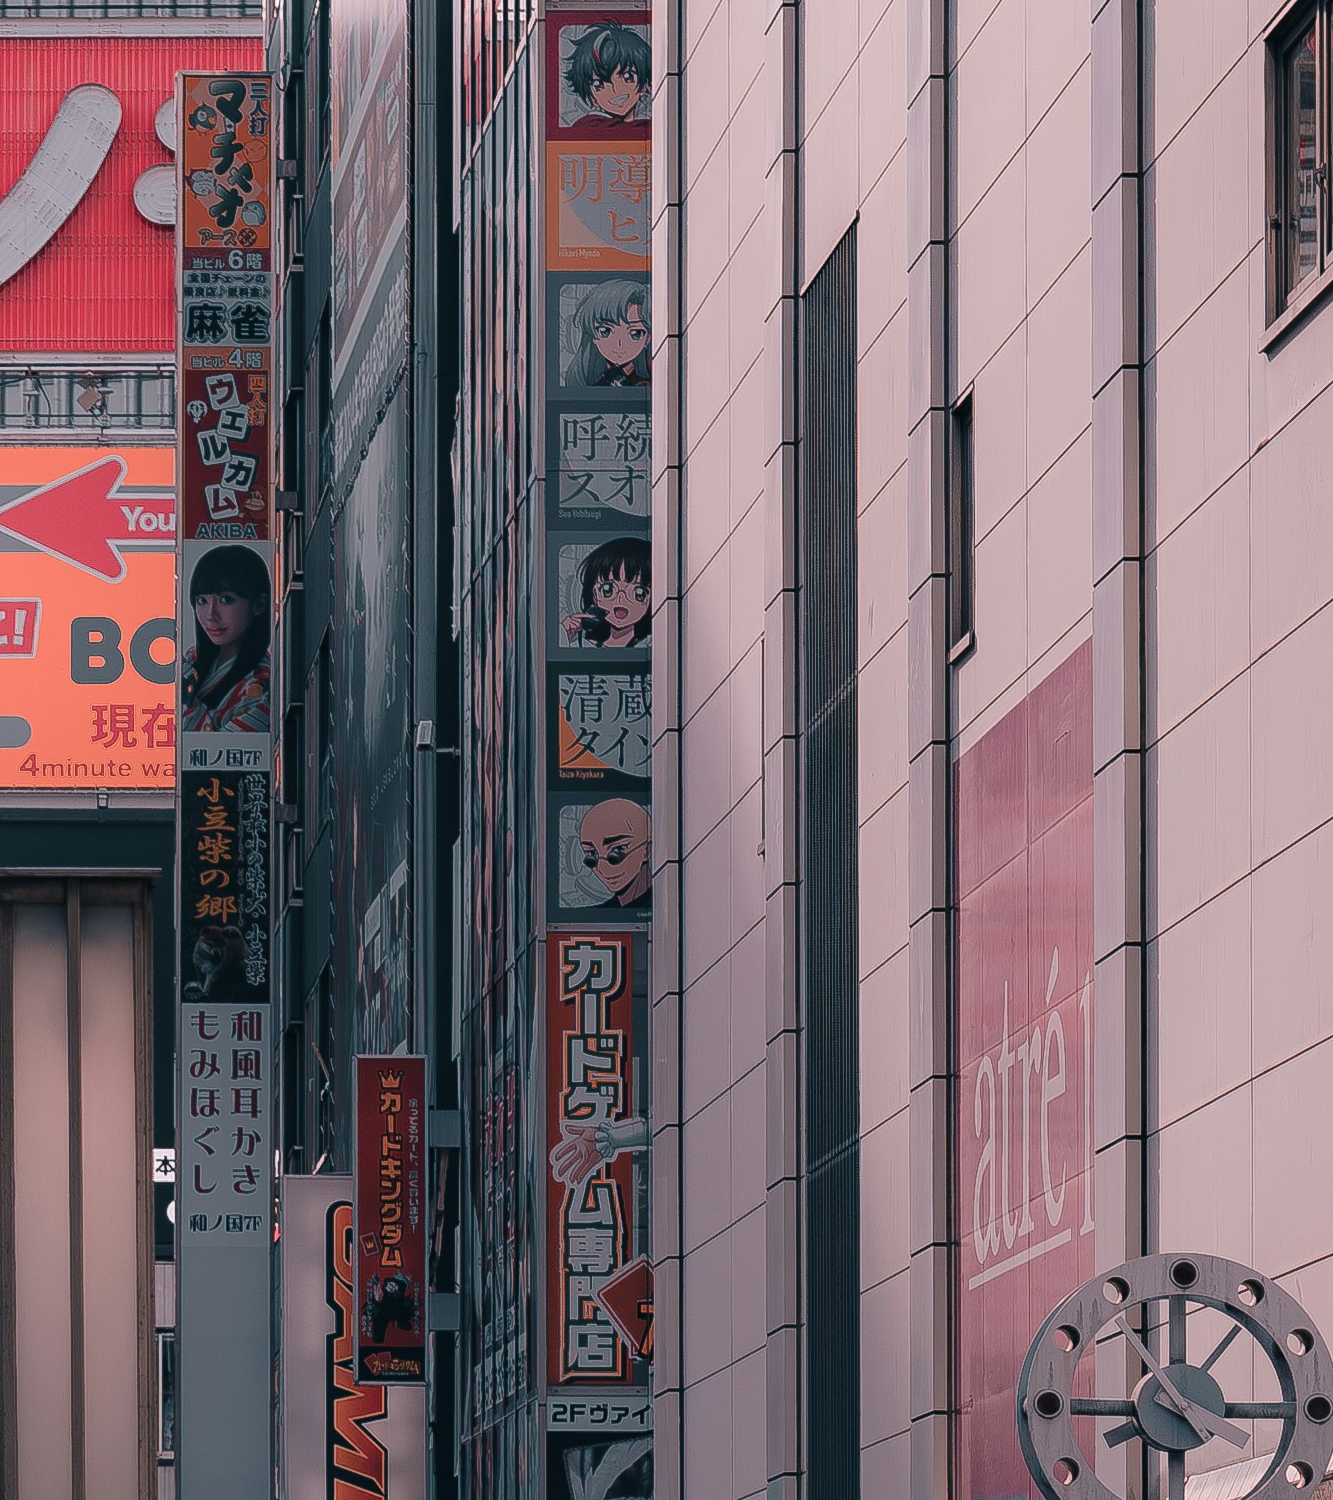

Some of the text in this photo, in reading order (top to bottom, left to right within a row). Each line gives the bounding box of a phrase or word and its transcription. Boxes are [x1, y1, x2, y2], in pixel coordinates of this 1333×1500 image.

[185, 302, 272, 344] 麻雀
[195, 522, 257, 540] AKIBA
[19, 752, 133, 778] 4minute
[194, 775, 238, 926] 小豆柴の郷
[189, 1011, 222, 1196] もみほぐし
[228, 1010, 264, 1196] 和風耳かき
